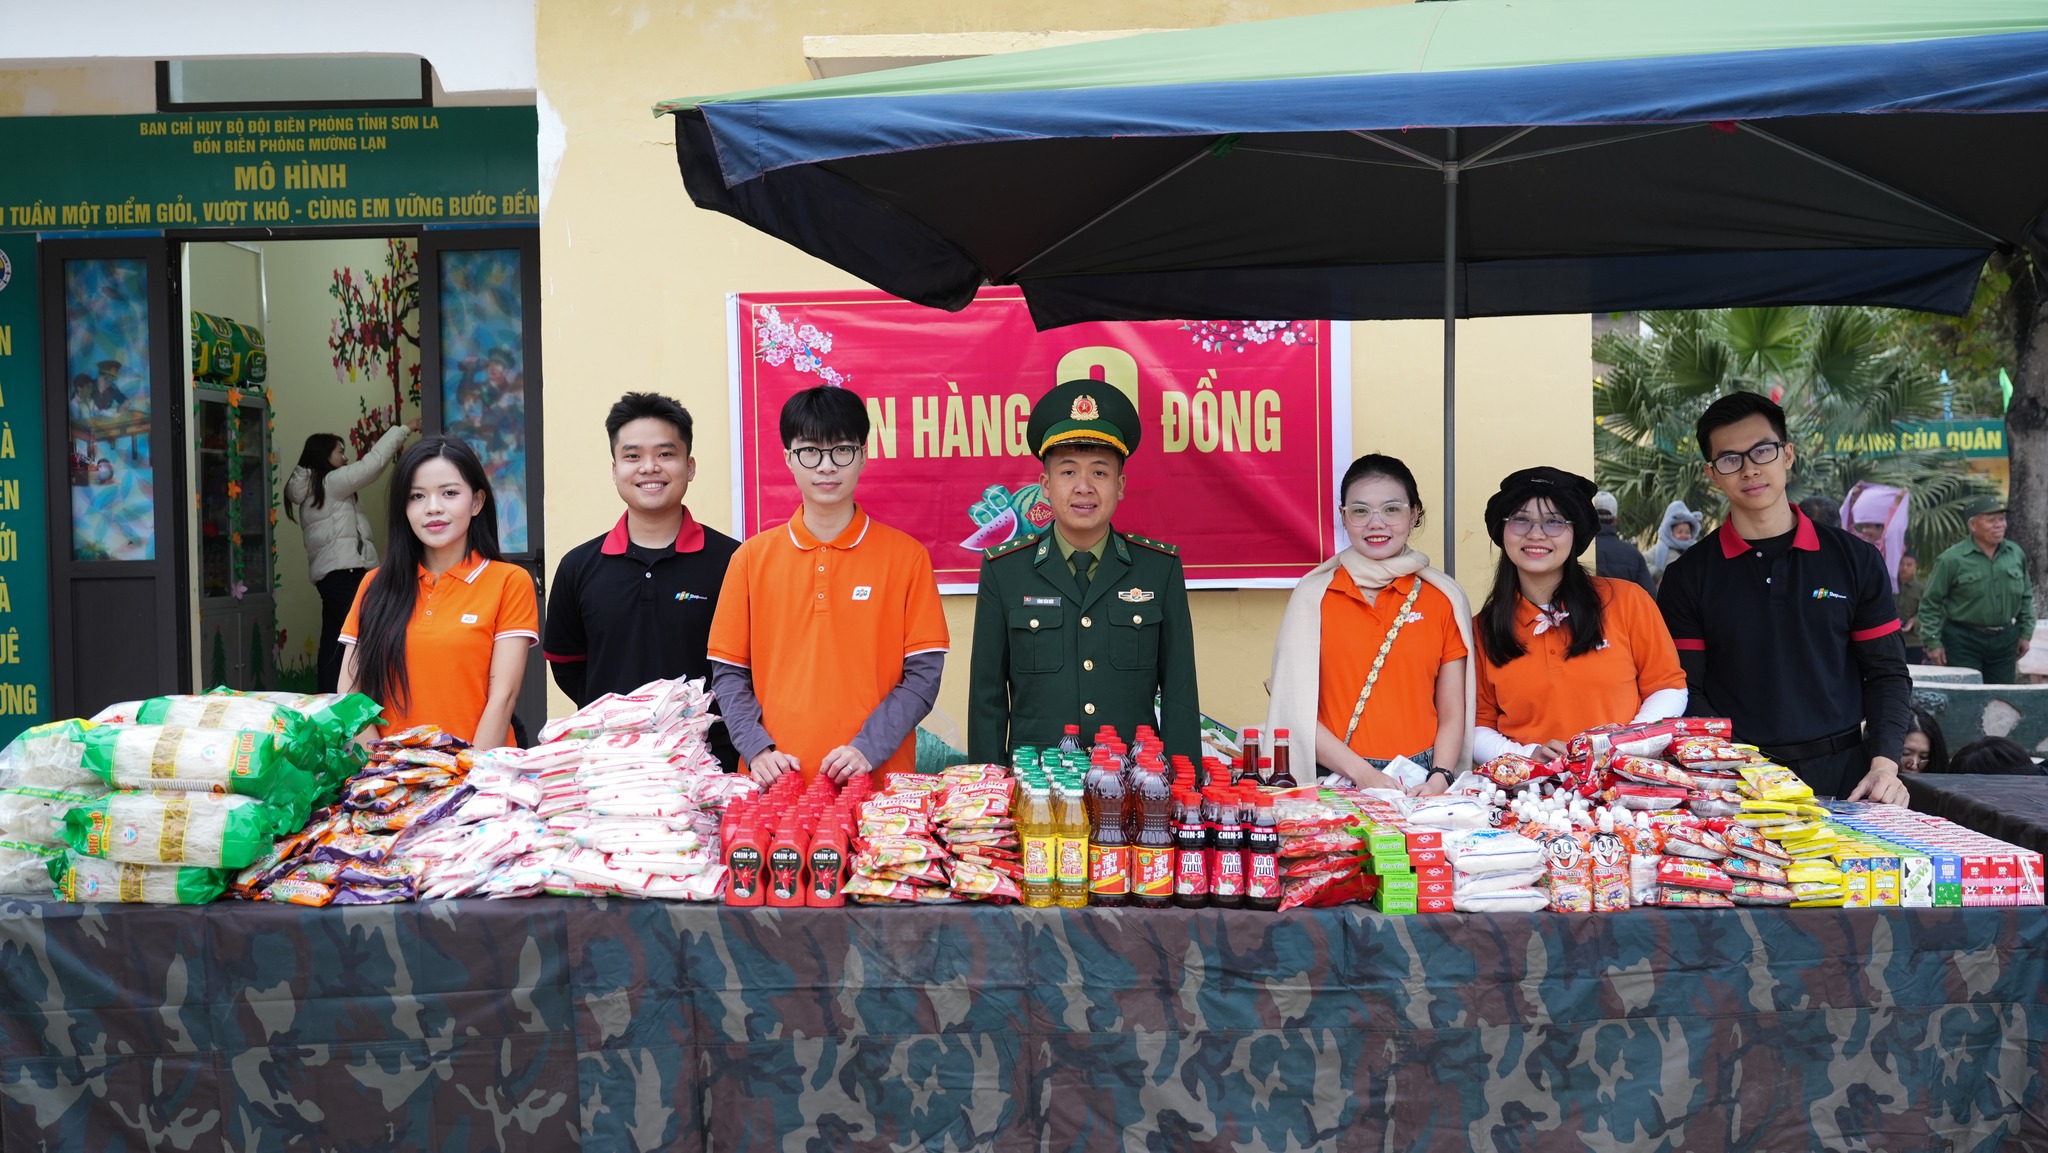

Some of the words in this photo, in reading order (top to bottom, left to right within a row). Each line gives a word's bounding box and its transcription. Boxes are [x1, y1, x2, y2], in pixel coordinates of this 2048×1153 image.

[140, 121, 167, 135] BAN
[171, 117, 193, 135] CHỈ
[197, 121, 222, 134] HUY
[226, 118, 244, 136] BỘ
[248, 117, 270, 136] ĐỘI
[309, 115, 354, 132] PHÒNG
[357, 112, 387, 131] TỈNH
[391, 115, 419, 129] SƠN
[422, 116, 439, 129] LA
[225, 137, 256, 153] BIÊN
[260, 136, 304, 152] PHÒNG
[309, 134, 356, 151] MƯỜNG
[361, 136, 386, 152] LẠN
[234, 160, 275, 191] MÔ
[284, 159, 346, 190] HÌNH
[10, 199, 56, 226] TUẦN
[62, 201, 100, 229] MỘT
[105, 196, 150, 224] ĐIỂM
[156, 194, 198, 225] GIỎI,
[202, 200, 248, 226] VƯỢT
[253, 196, 290, 221] KHÓ
[308, 195, 357, 220] CÙNG
[362, 197, 390, 218] EM
[395, 192, 443, 218] VỮNG
[449, 190, 497, 216] BƯỚC
[502, 188, 538, 215] ĐẾN
[912, 381, 1032, 458] HÀNG
[1161, 368, 1281, 453] ĐỒNG
[1946, 427, 2002, 452] QUÂN
[0, 682, 37, 716] ƠNG
[1179, 830, 1205, 839] CHIN-SU
[1251, 833, 1277, 842] CHIN-SU
